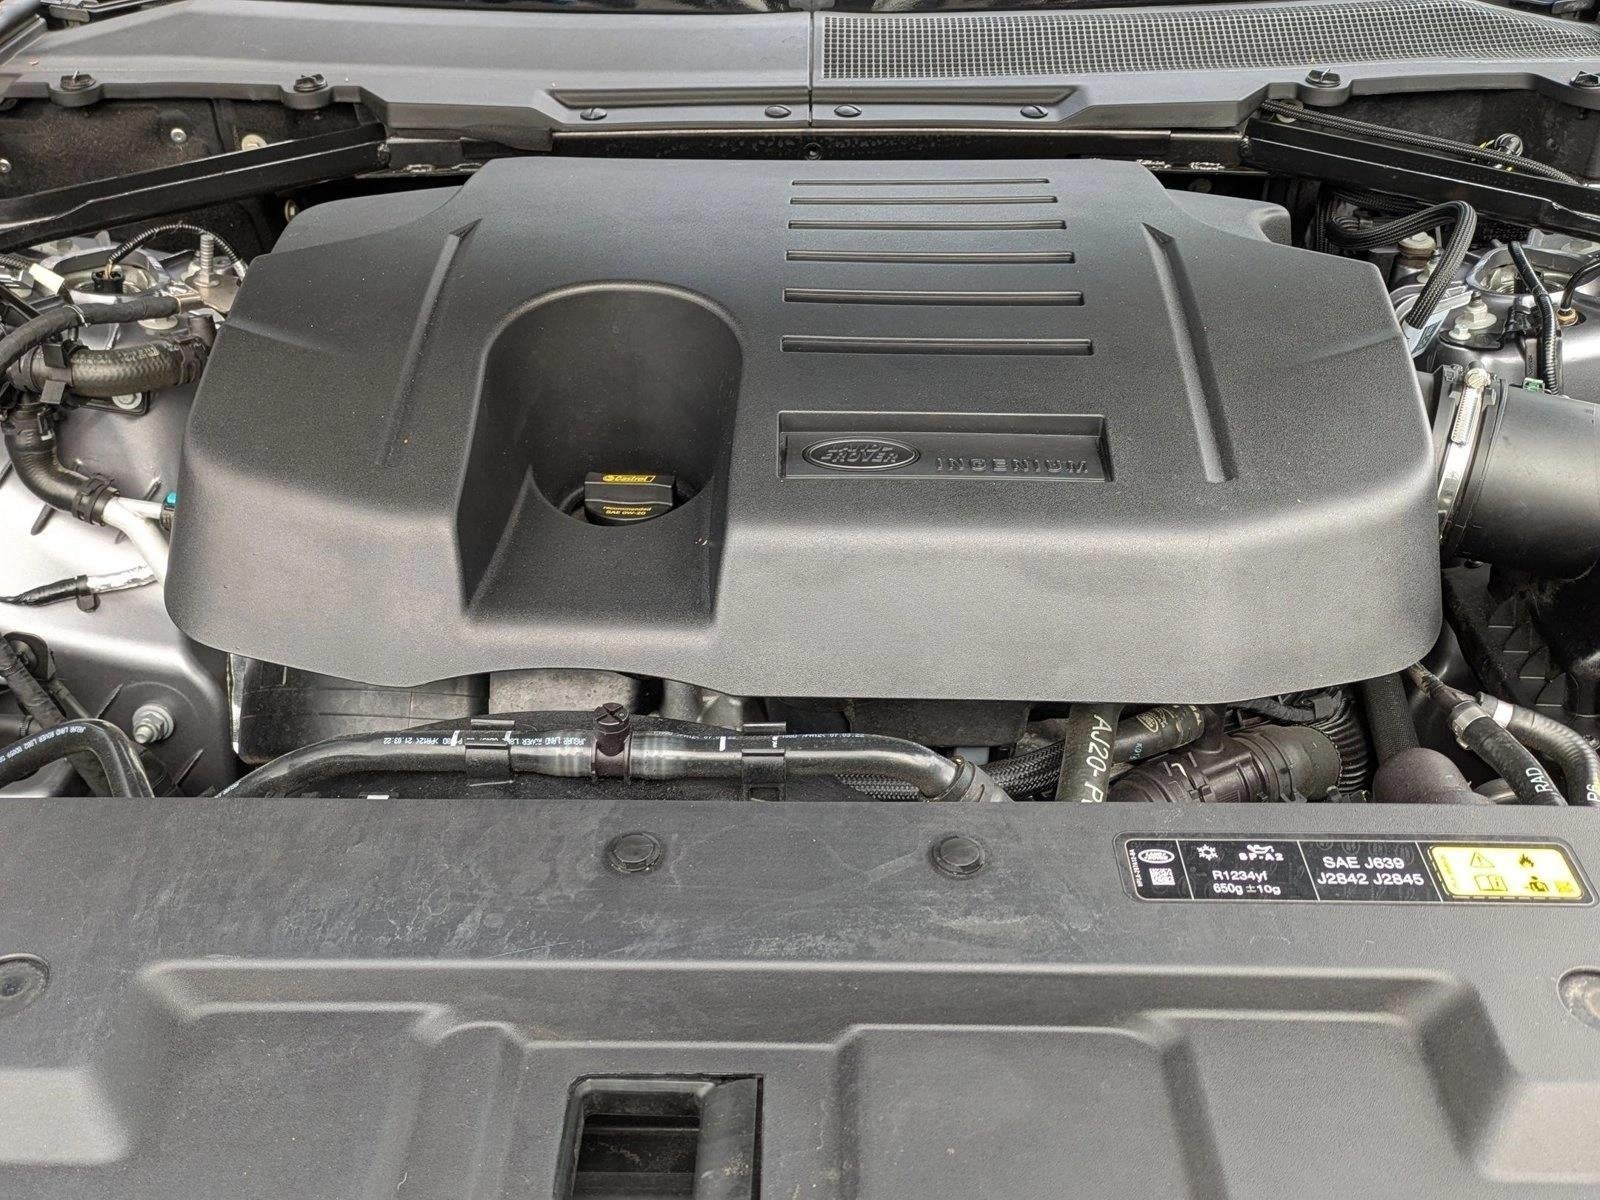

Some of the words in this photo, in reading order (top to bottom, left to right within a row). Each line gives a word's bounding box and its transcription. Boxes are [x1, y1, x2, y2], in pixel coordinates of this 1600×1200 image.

[935, 456, 1089, 474] INGENIUM
[544, 736, 561, 746] LAND
[1525, 767, 1554, 794] RAD
[1322, 856, 1361, 869] SAE
[1364, 857, 1405, 870] J639
[1212, 869, 1268, 883] R1234yf
[1317, 872, 1370, 886] J2842
[1372, 873, 1425, 887] J2845
[1213, 883, 1244, 896] 650g
